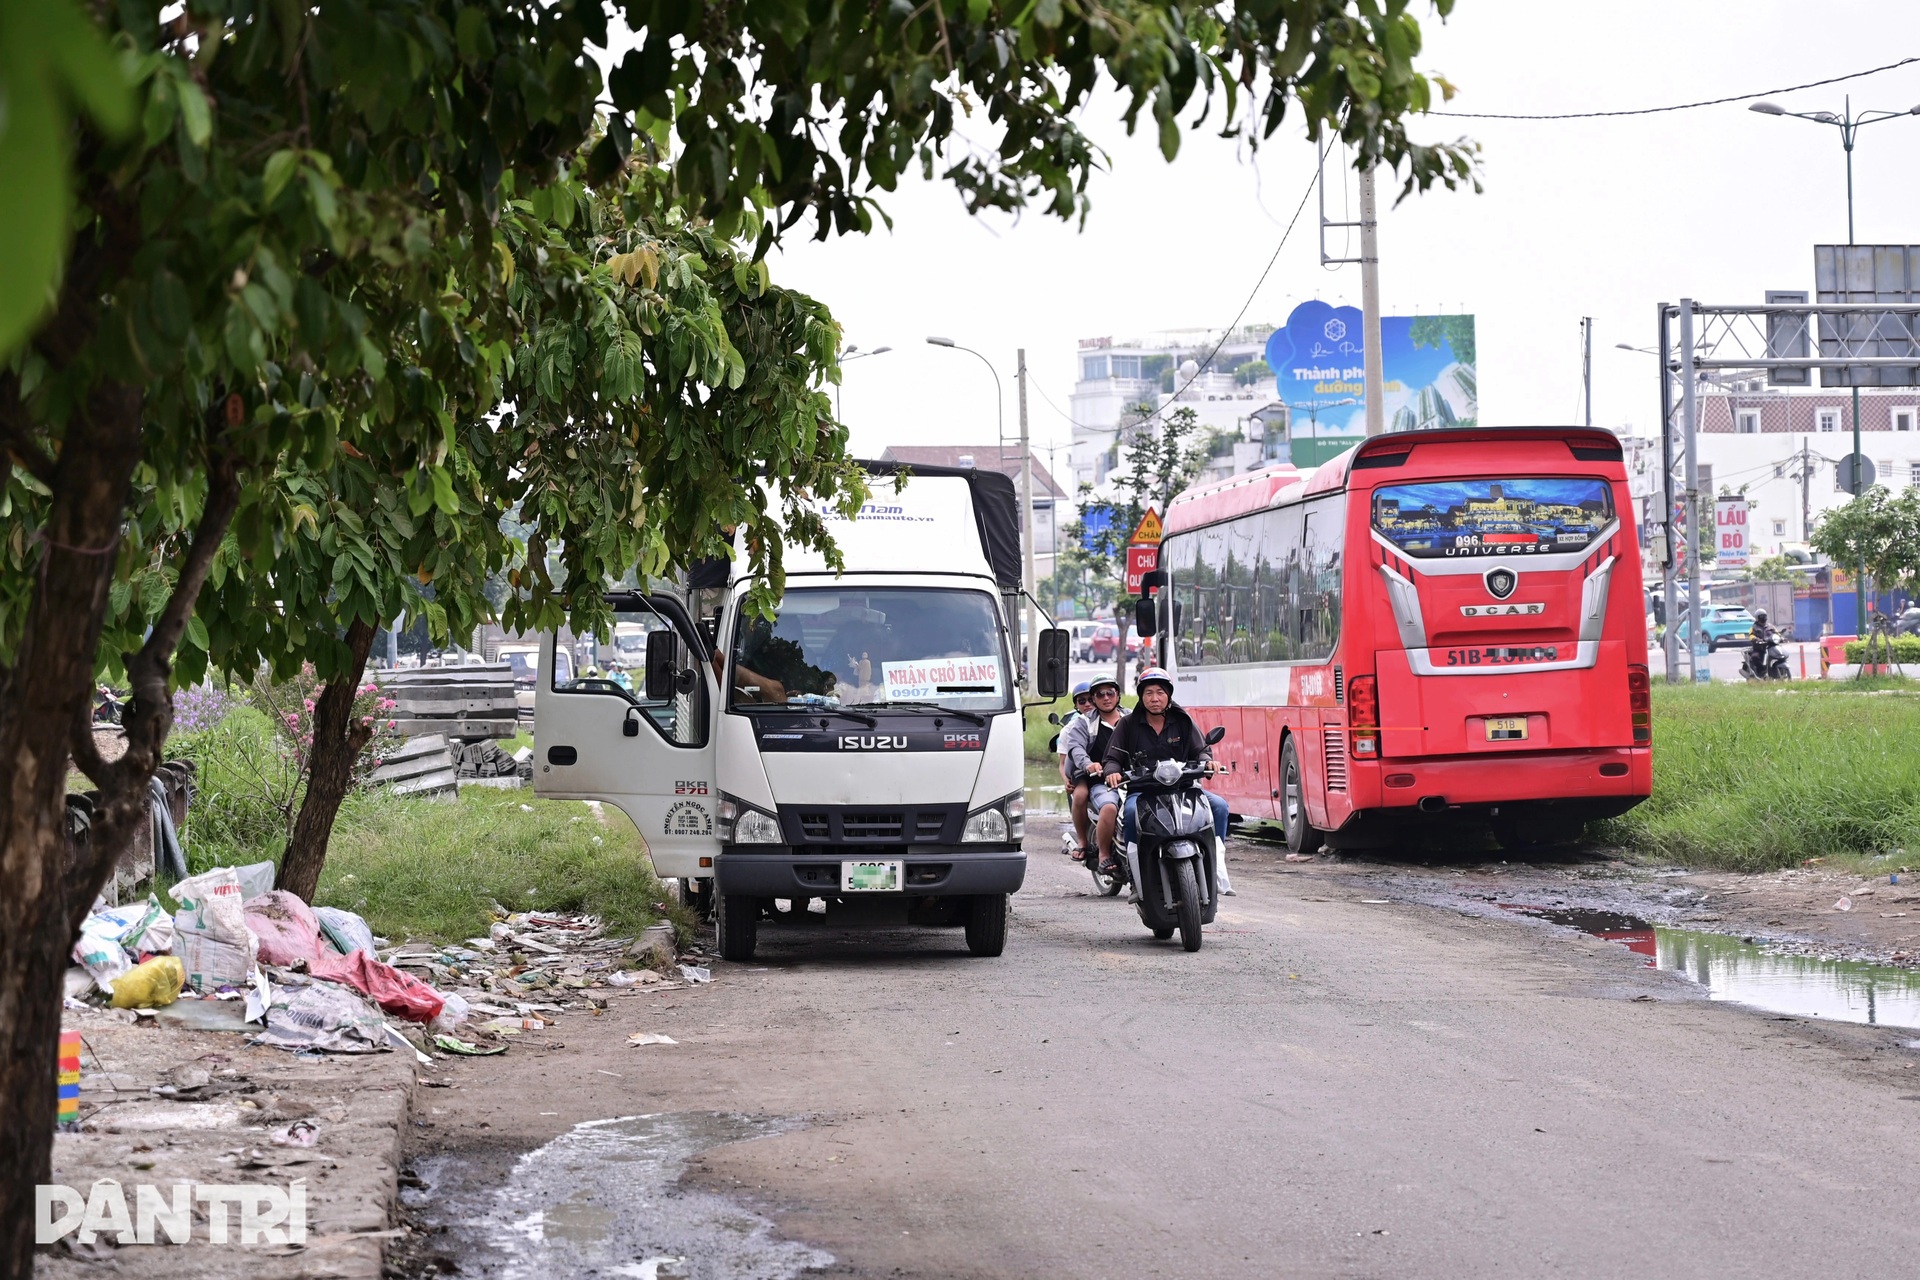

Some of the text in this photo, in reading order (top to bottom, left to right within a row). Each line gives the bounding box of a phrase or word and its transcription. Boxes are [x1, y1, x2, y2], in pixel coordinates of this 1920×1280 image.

[1293, 366, 1366, 380] Thành ph
[1717, 504, 1747, 526] LẨU
[1146, 520, 1155, 528] ĐI
[1722, 529, 1743, 548] BÒ
[1137, 552, 1156, 567] CHÚ
[1129, 574, 1141, 587] QU
[1465, 605, 1539, 615] DCAR
[888, 660, 996, 687] NHẬN CHỞ HÀNG
[892, 688, 929, 698] 0907
[1497, 720, 1515, 729] 51B
[838, 736, 908, 749] ISUZU
